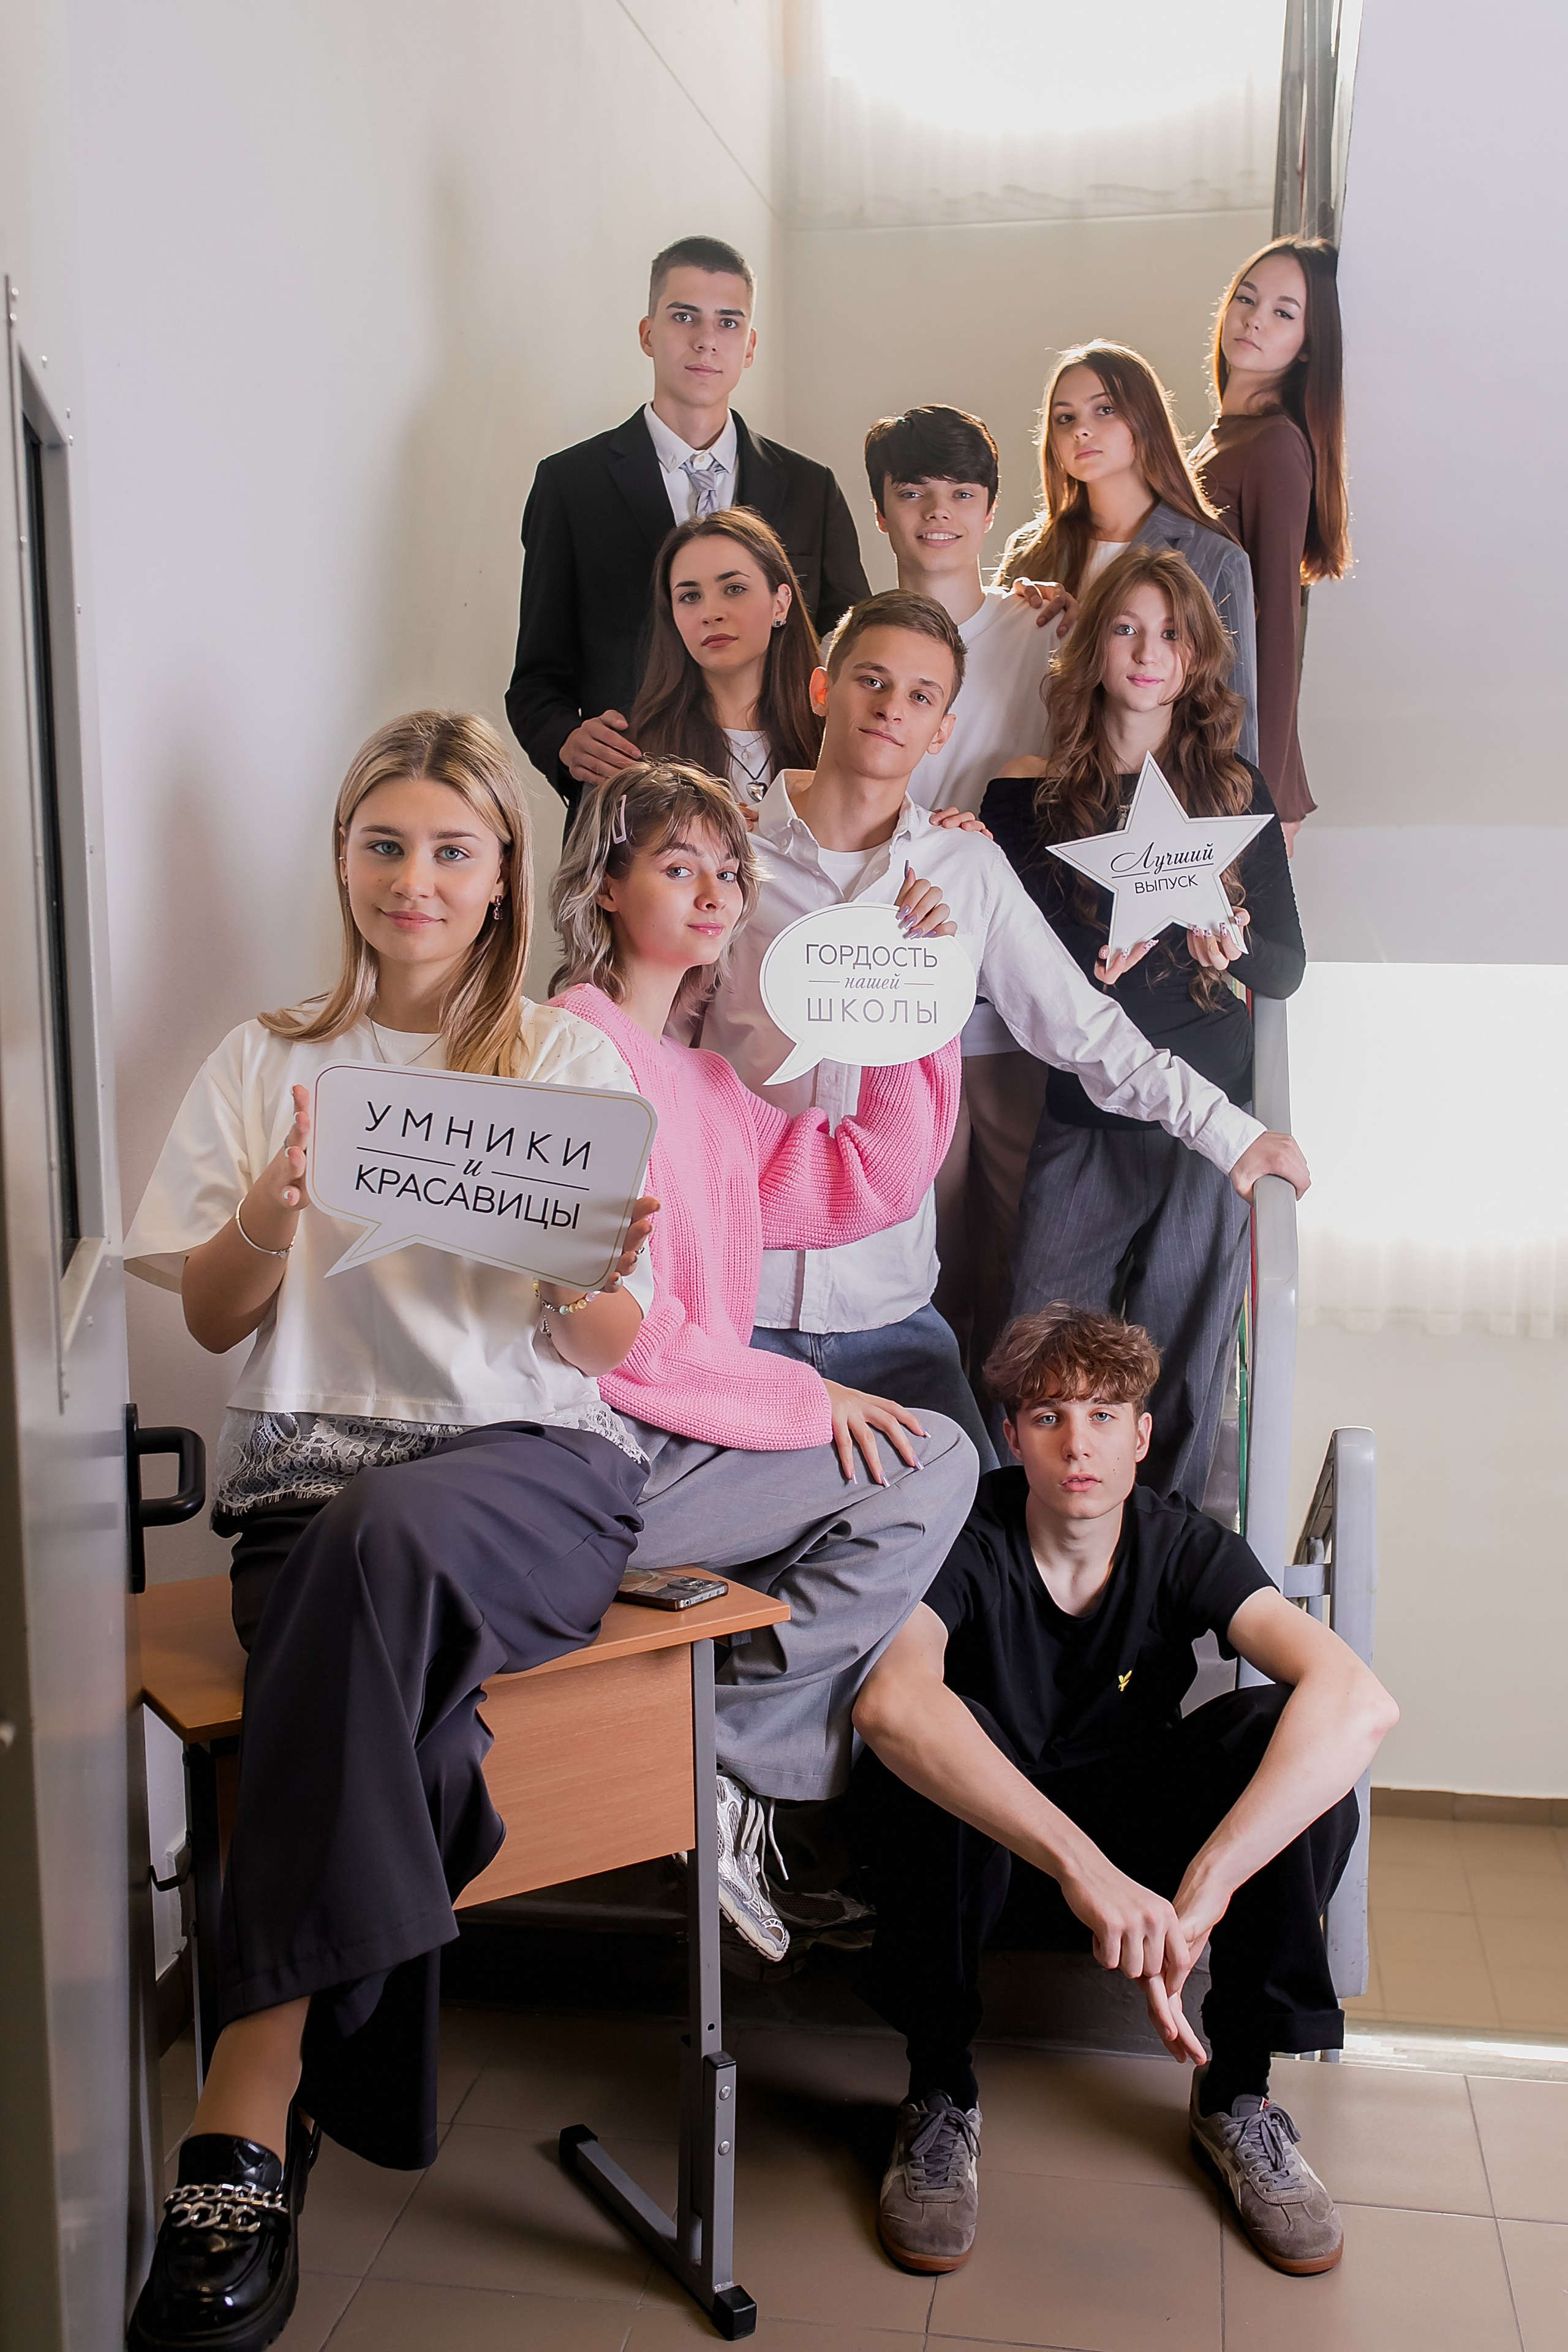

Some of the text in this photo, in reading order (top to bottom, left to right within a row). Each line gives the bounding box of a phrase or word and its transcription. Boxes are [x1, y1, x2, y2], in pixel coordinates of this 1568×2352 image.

[1110, 842, 1214, 874] Лучший
[1134, 875, 1198, 894] ВЫПУСК
[806, 944, 938, 970] ГОРДОСТЬ
[845, 973, 900, 989] нашей
[807, 998, 937, 1023] ШКОЛЫ
[365, 1101, 591, 1170] УМНИКИ
[463, 1159, 483, 1177] и
[355, 1164, 580, 1230] КРАСАВИЦЫ
